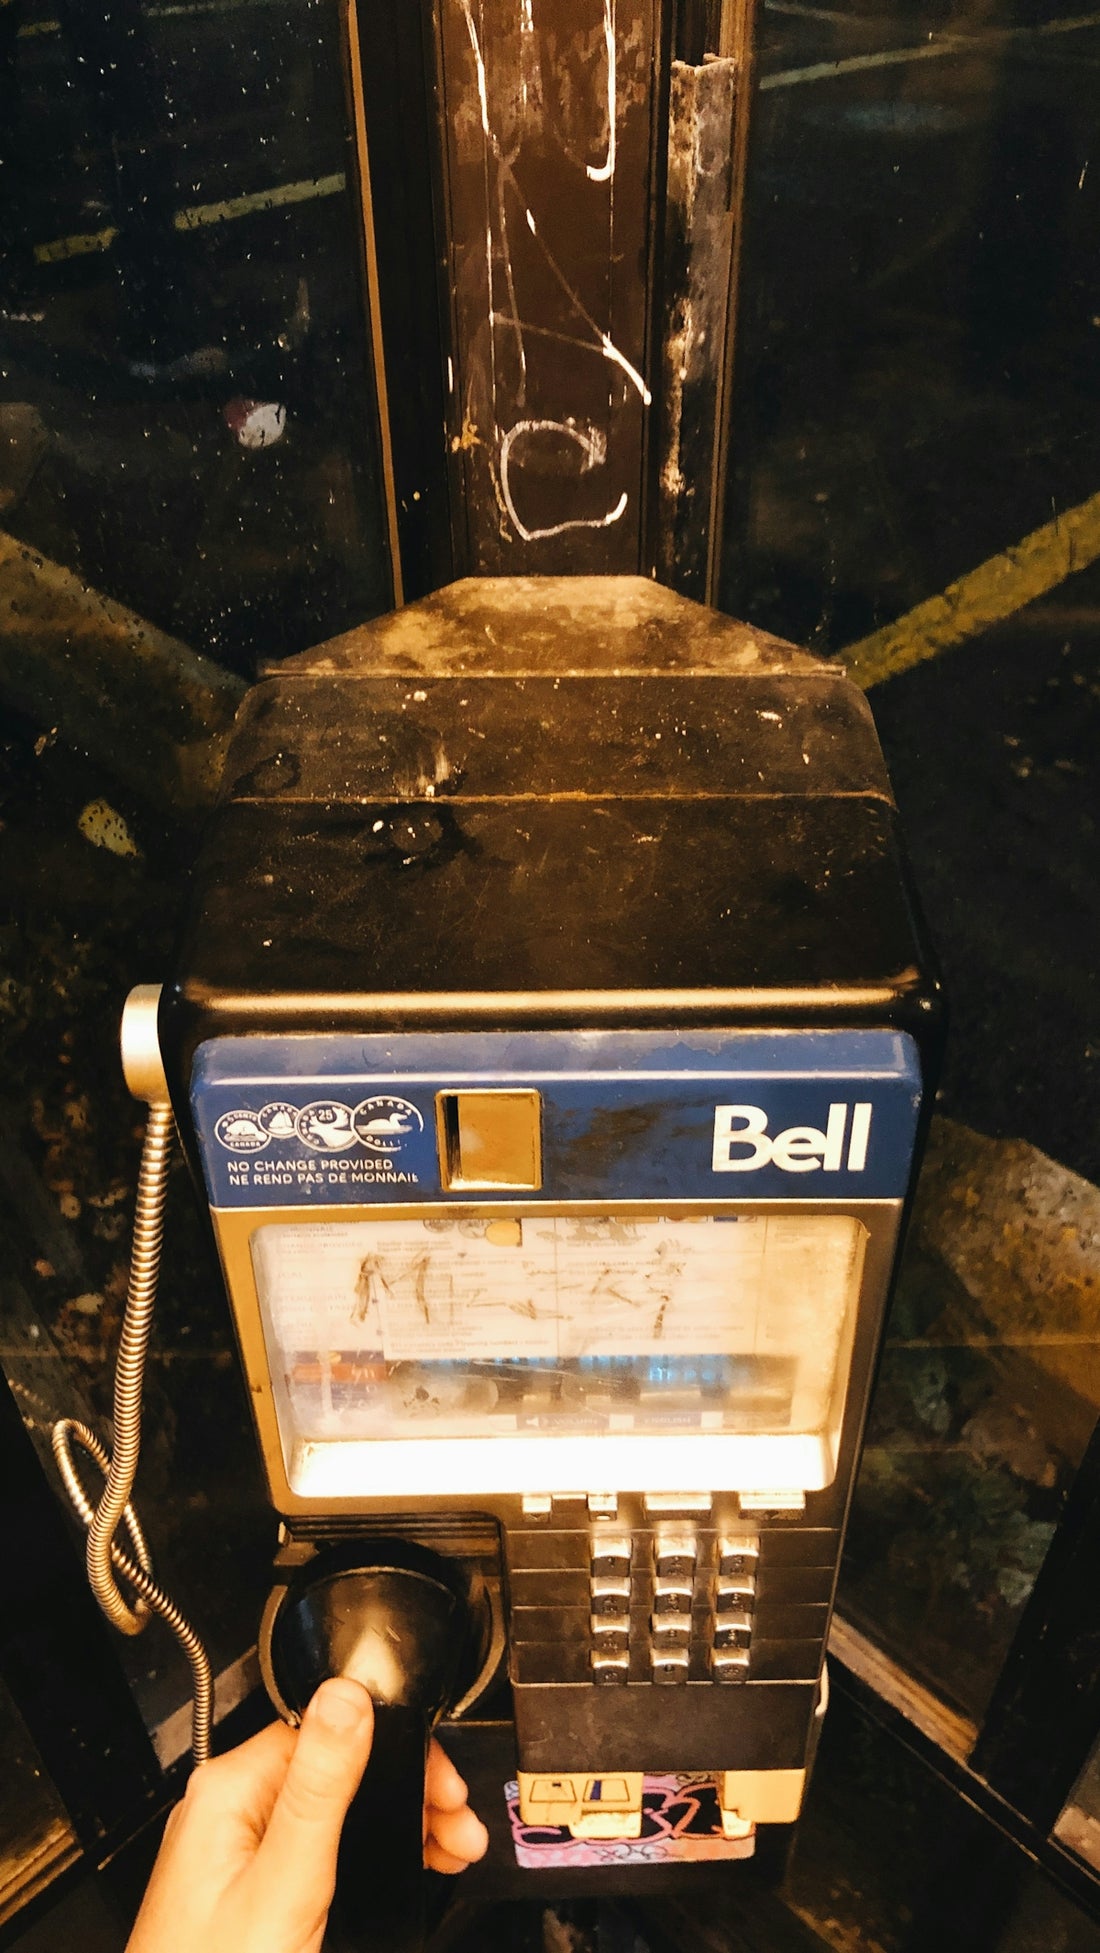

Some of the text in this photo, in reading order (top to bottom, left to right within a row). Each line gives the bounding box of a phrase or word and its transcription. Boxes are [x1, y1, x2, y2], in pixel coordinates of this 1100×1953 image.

[359, 1099, 412, 1116] CANADA
[318, 1109, 333, 1121] 25
[366, 1134, 408, 1148] DOLL
[712, 1102, 873, 1172] Bell
[229, 1140, 261, 1149] CANADA
[227, 1158, 394, 1173] NO CHANGE PROVIDED
[229, 1173, 249, 1186] NE
[254, 1173, 292, 1185] REND
[298, 1172, 324, 1184] PAS
[328, 1172, 347, 1184] DE
